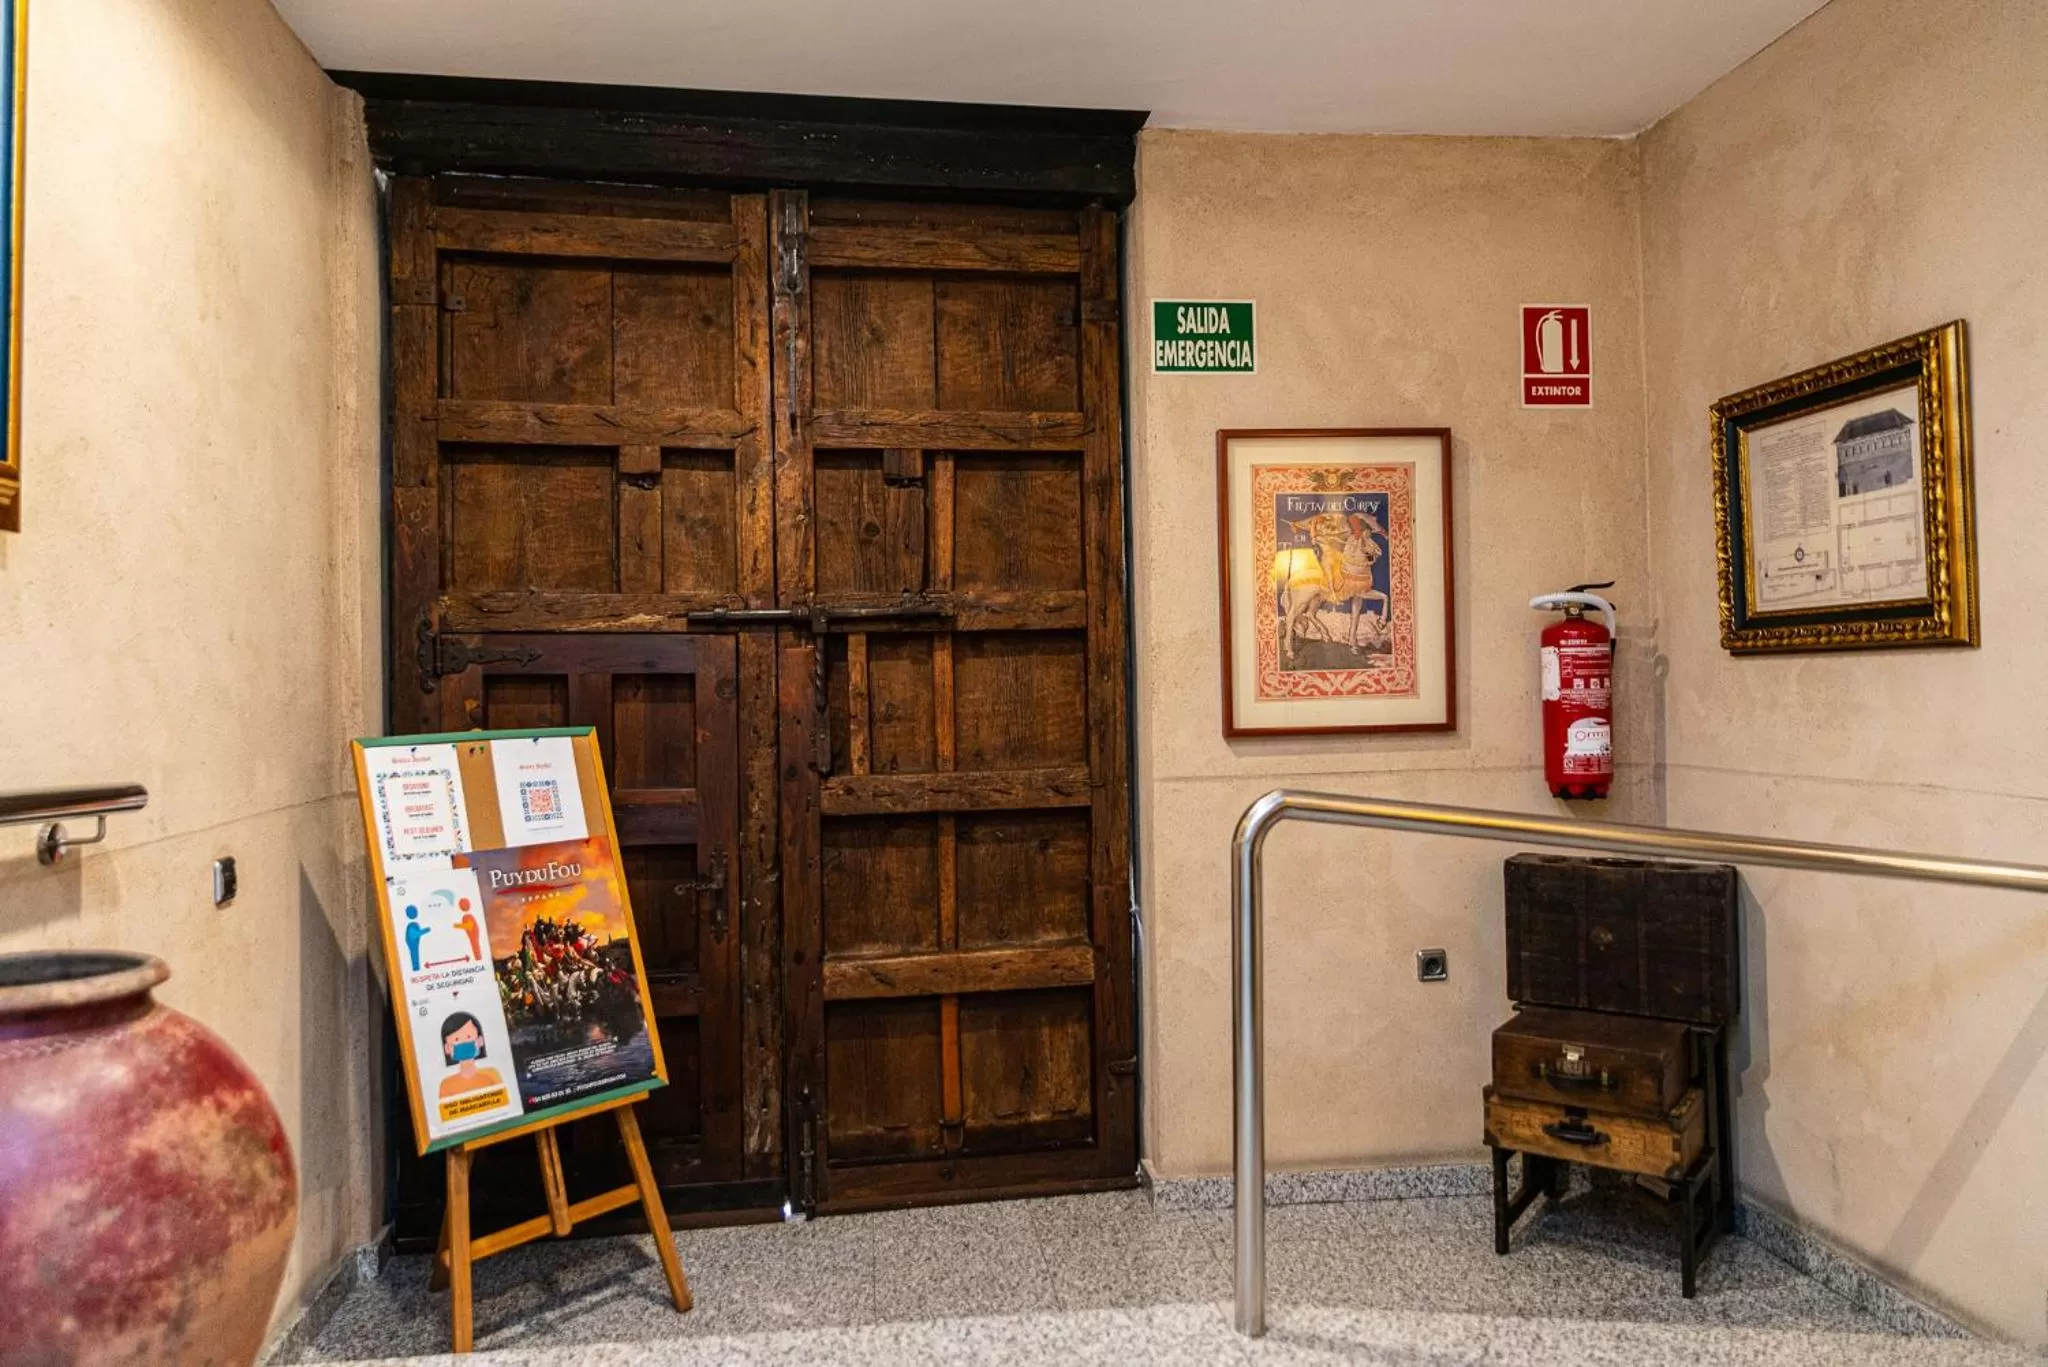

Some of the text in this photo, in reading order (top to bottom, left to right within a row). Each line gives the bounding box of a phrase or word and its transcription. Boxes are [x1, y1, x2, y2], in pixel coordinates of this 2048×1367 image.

[1176, 305, 1231, 334] SALIDA
[1156, 339, 1253, 368] EMERGENCIA
[1531, 386, 1582, 396] EXTINTOR
[411, 973, 441, 983] RESPETA
[451, 965, 485, 977] DISTANCIA
[436, 976, 475, 990] SEGURIDAD
